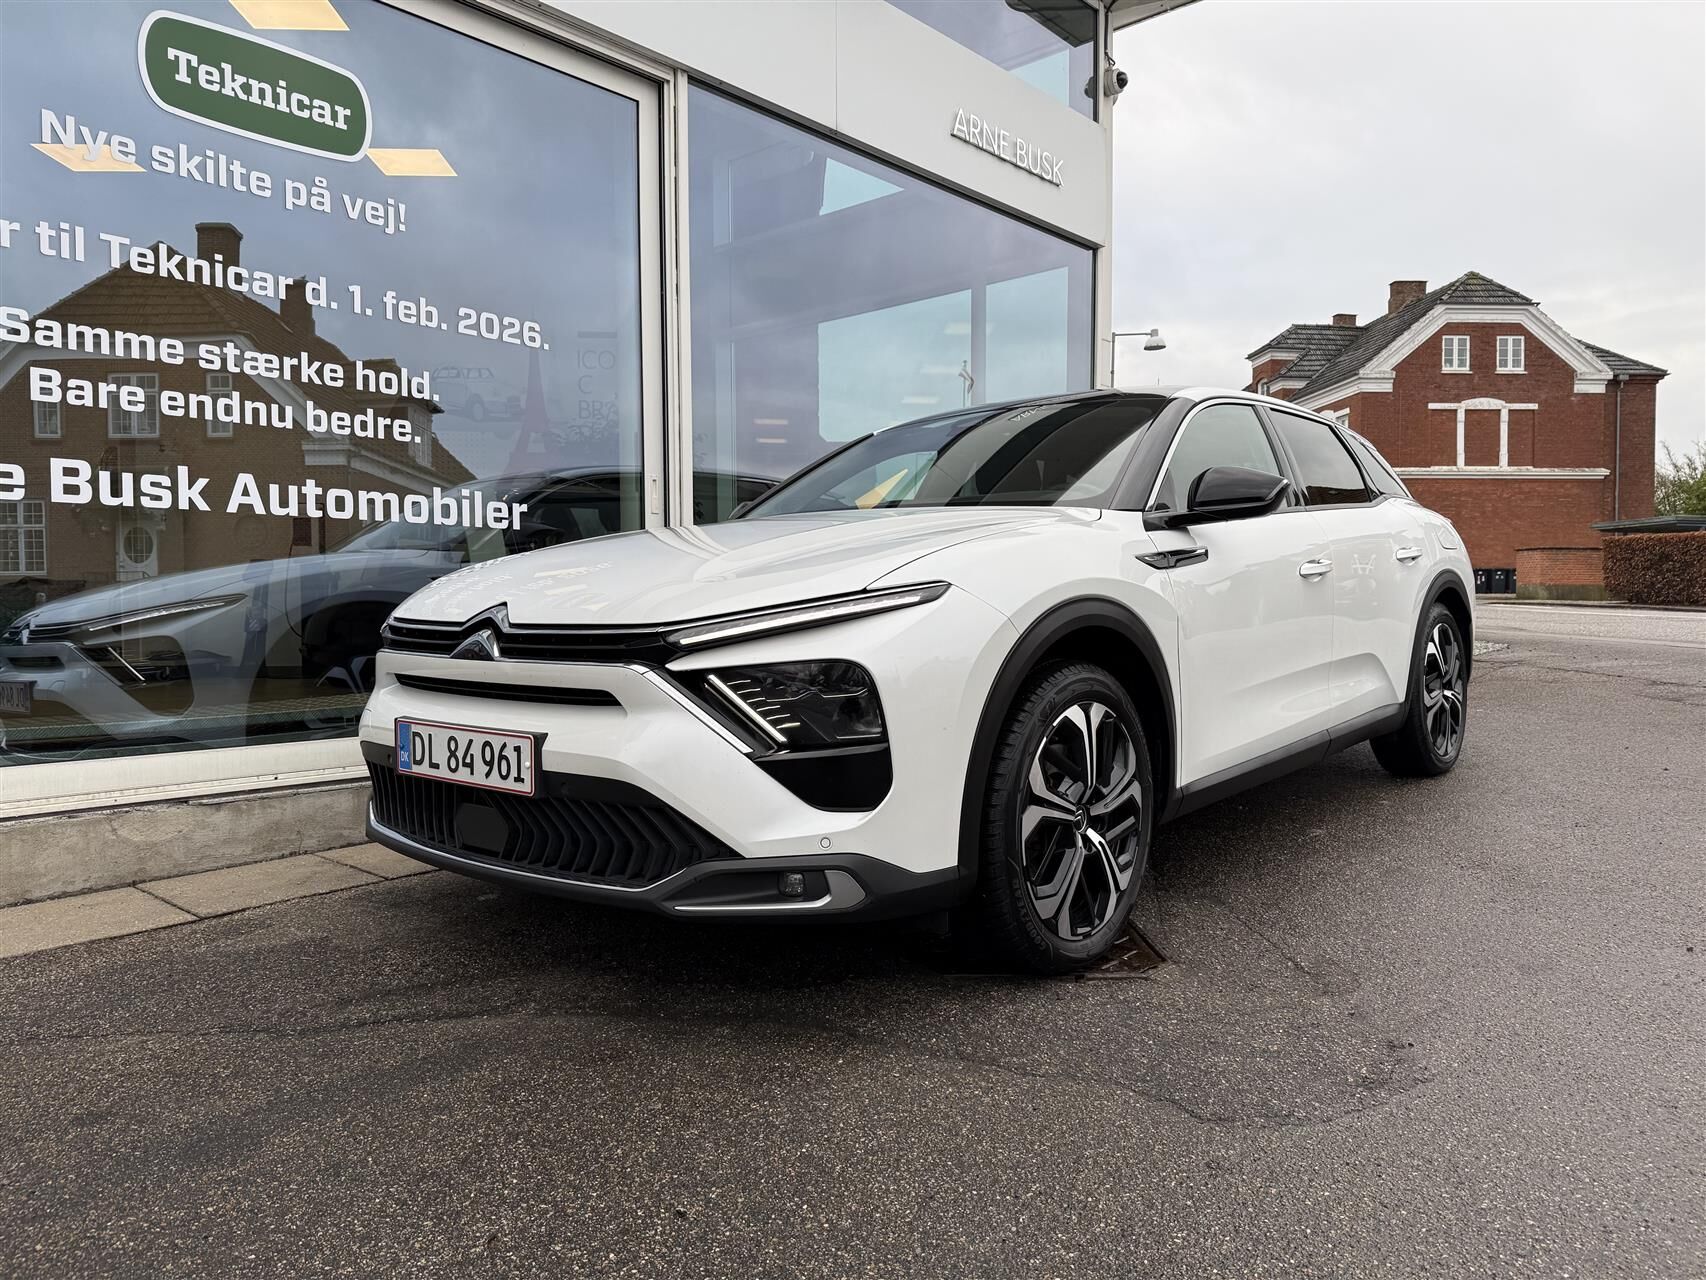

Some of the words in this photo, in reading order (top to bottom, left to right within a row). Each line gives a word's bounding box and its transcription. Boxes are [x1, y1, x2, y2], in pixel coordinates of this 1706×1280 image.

[167, 47, 351, 131] Teknicar
[40, 109, 137, 164] Nye
[151, 144, 272, 198] skilte
[286, 176, 331, 212] på
[342, 193, 406, 235] vej!
[952, 107, 1010, 161] ARNE
[1016, 137, 1065, 188] BUSK
[35, 221, 85, 262] til
[100, 232, 294, 300] Teknicar
[306, 277, 338, 310] d.
[349, 285, 373, 316] 1.
[383, 291, 448, 331] feb.
[457, 308, 550, 350] 2026.
[0, 306, 185, 365] Samme
[199, 343, 344, 388] stærke
[356, 361, 440, 400] hold.
[30, 366, 145, 413] Bare
[160, 391, 293, 429] endnu
[307, 401, 421, 443] bedre.
[50, 457, 211, 511] Busk
[226, 472, 528, 531] Automobiler
[412, 731, 441, 770] DL
[447, 735, 475, 776] 84
[481, 740, 525, 784] 961
